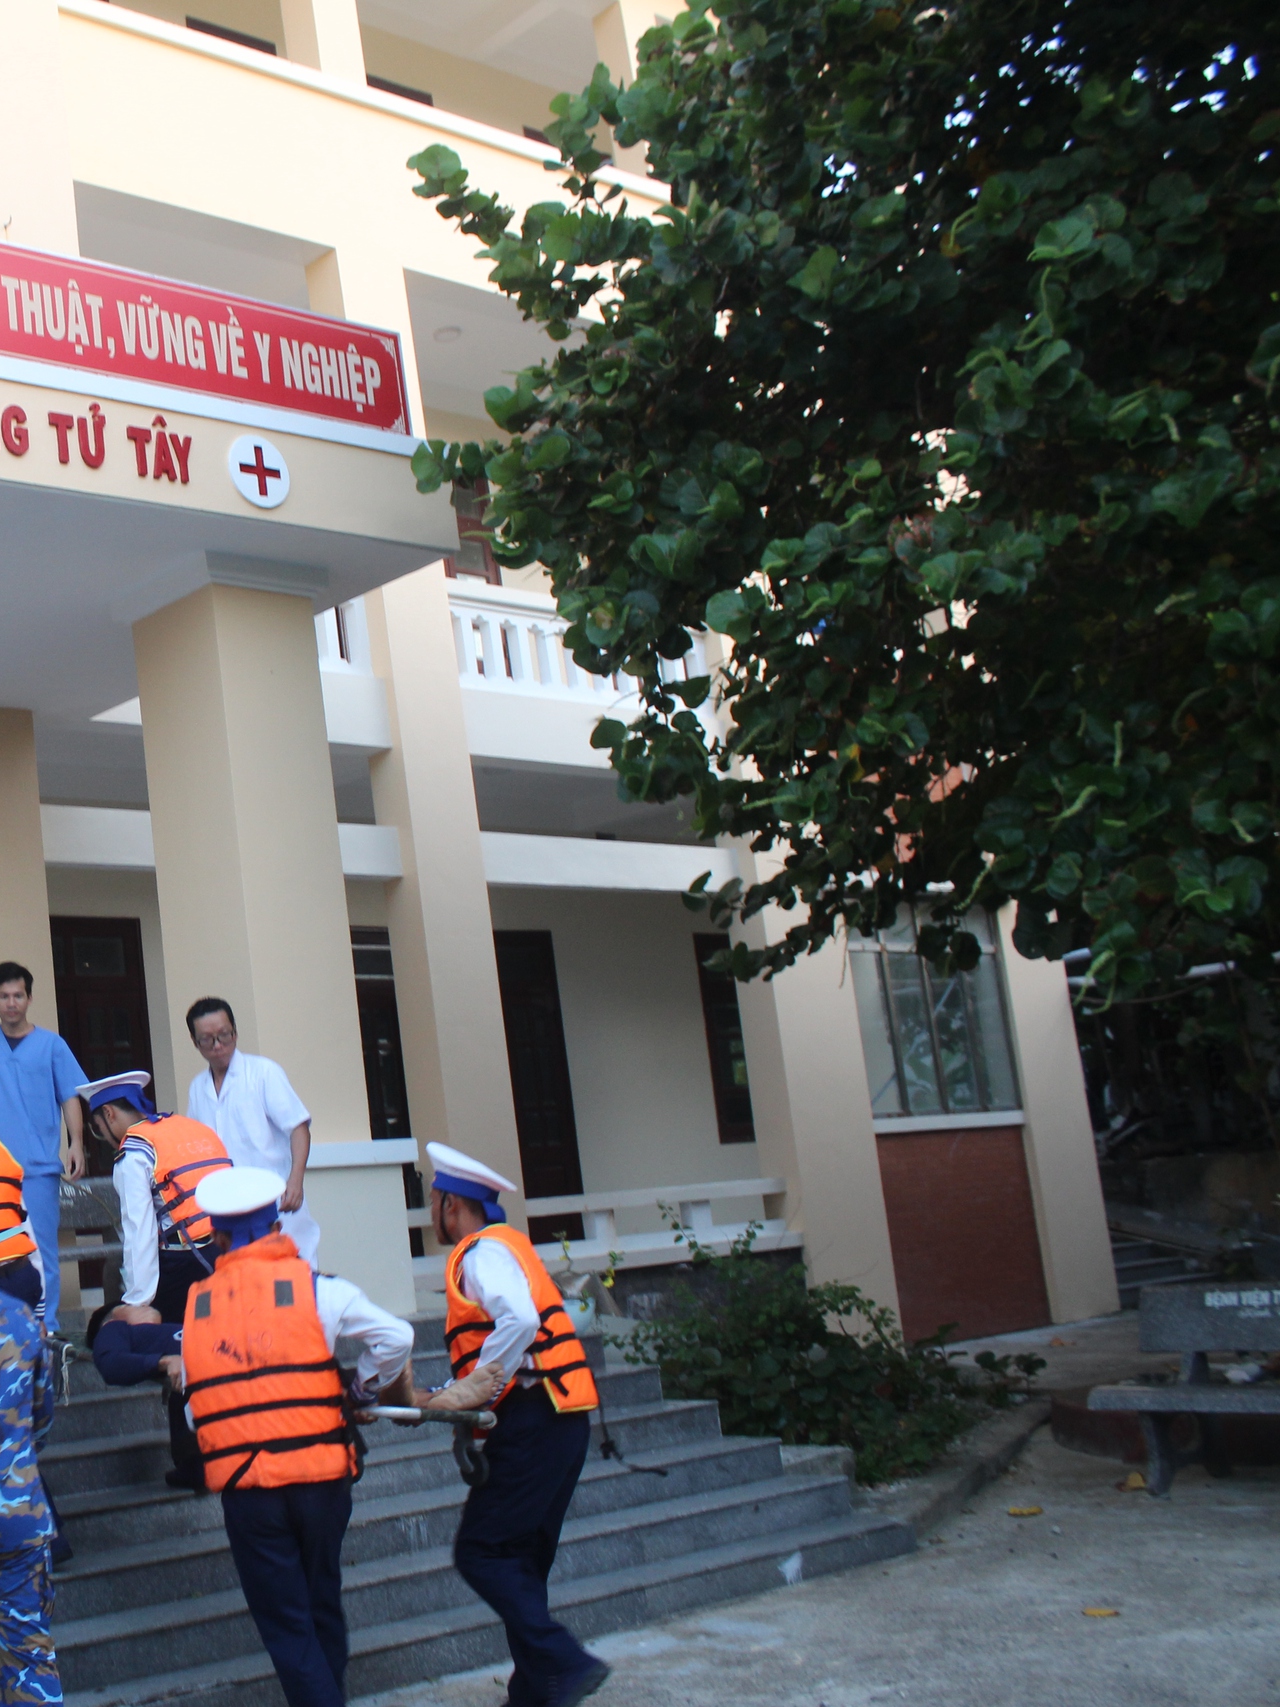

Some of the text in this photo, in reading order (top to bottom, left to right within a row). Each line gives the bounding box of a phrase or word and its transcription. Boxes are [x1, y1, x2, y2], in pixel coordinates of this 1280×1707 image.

[0, 278, 116, 358] THUẬT,
[116, 294, 207, 370] VỮNG
[208, 306, 249, 379] VỀ
[253, 330, 271, 384] Y
[279, 343, 382, 413] NGHIỆP
[126, 414, 192, 484] TÂY
